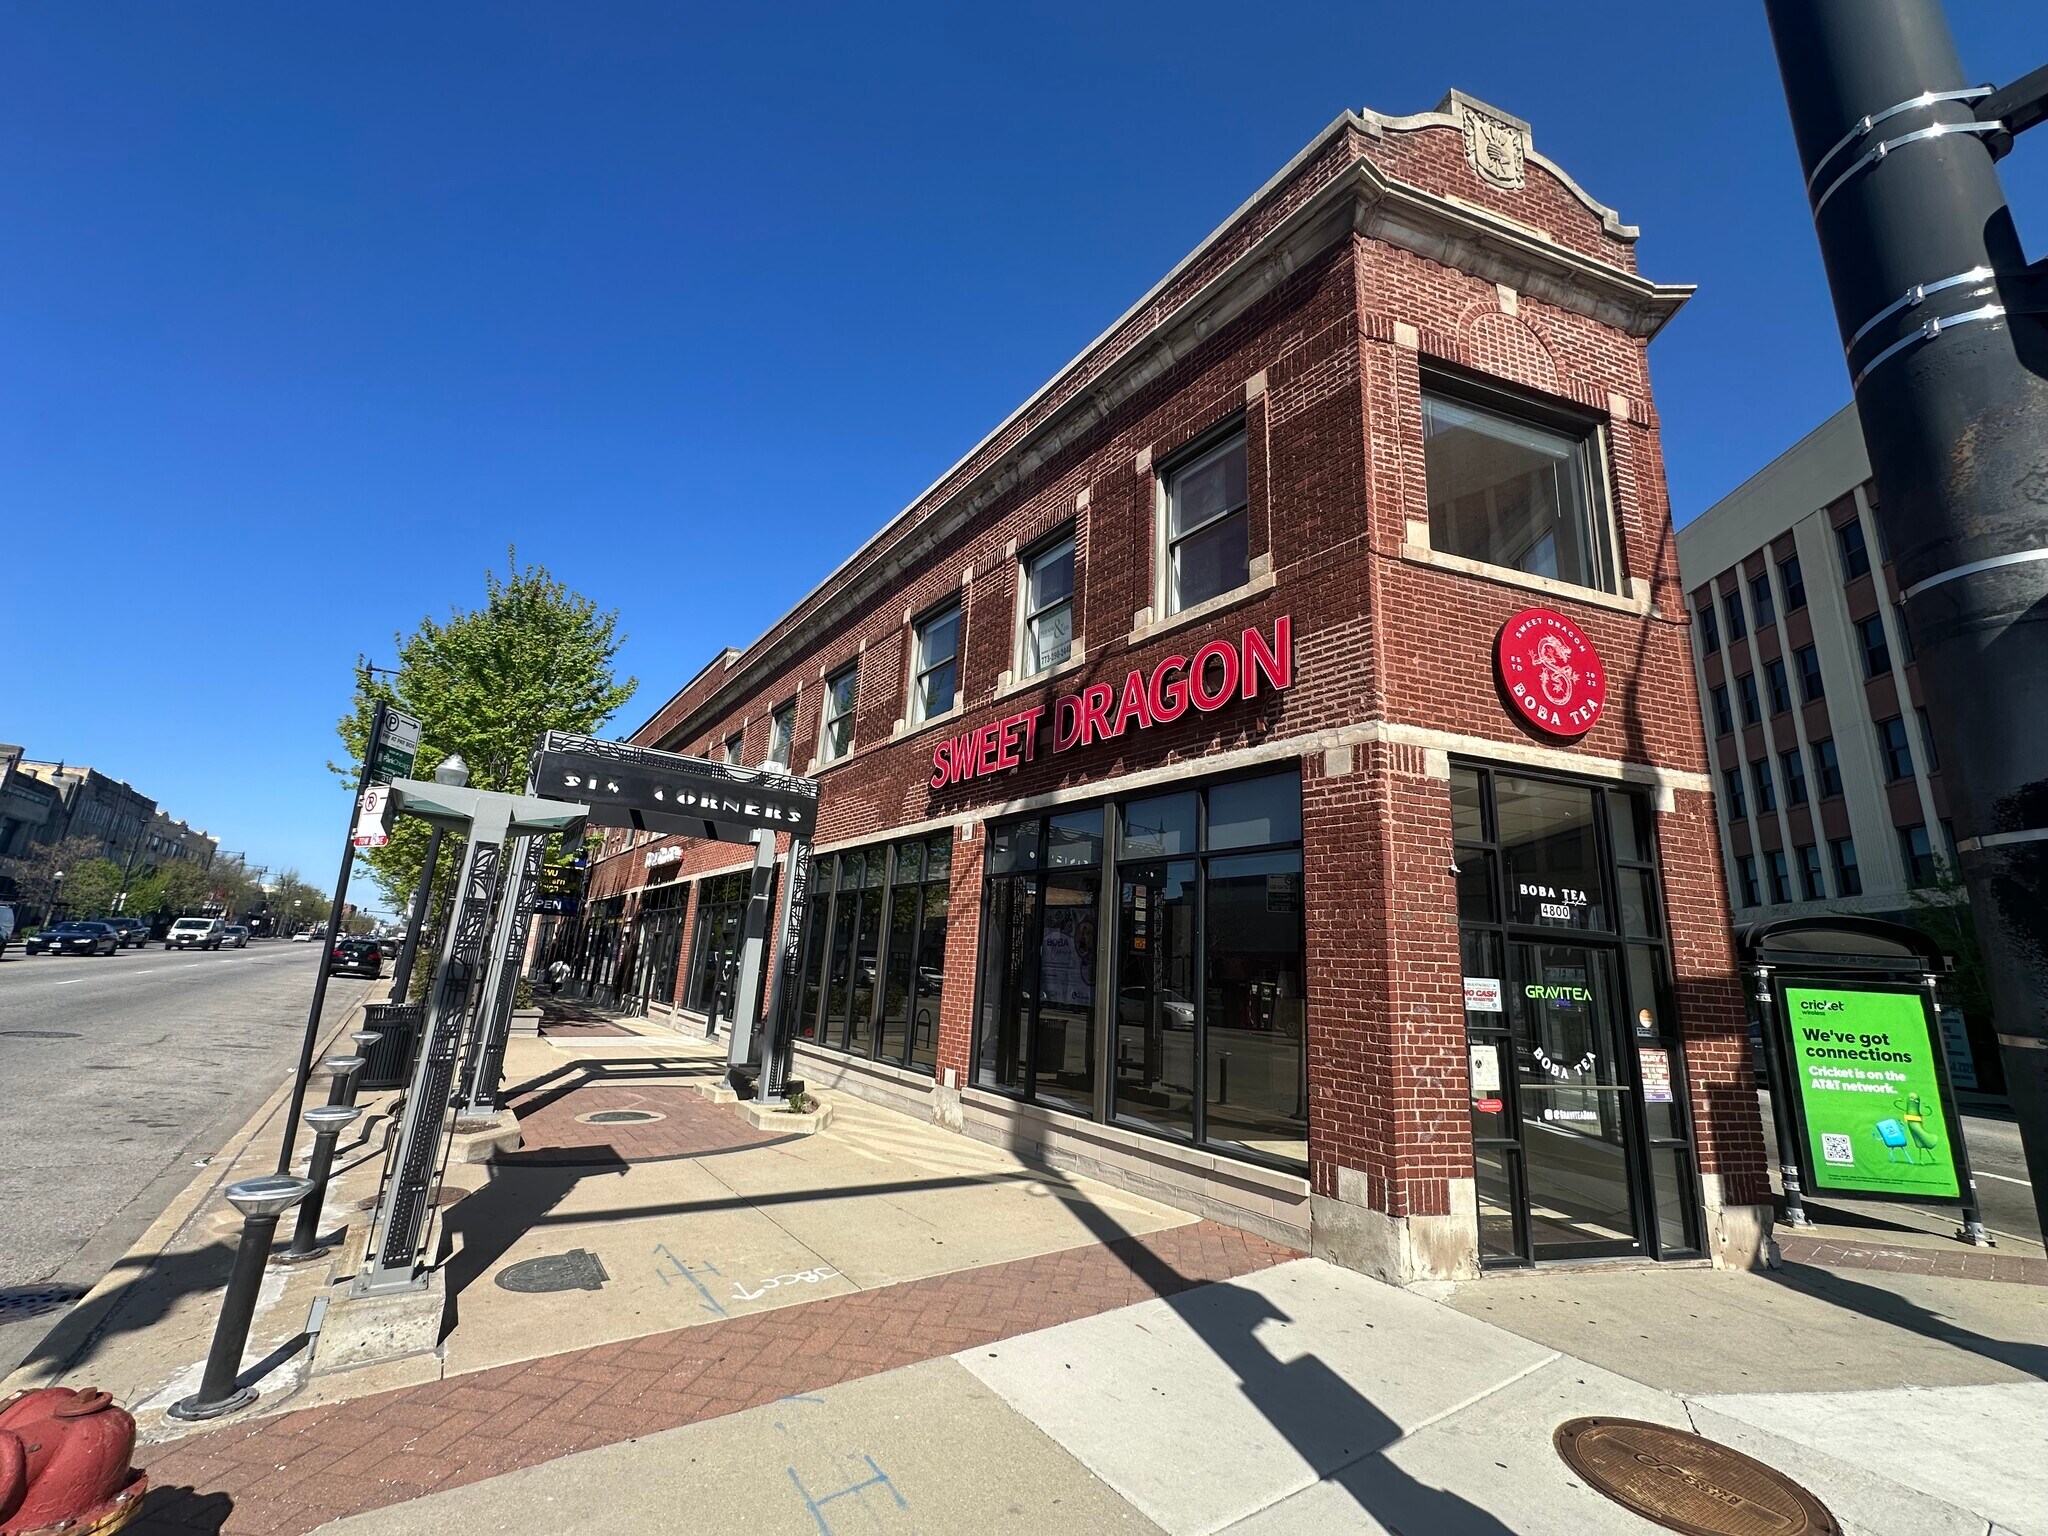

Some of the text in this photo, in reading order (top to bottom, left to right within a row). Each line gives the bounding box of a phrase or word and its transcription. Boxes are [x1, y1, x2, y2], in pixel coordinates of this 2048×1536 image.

[1515, 618, 1587, 653] SWEET DRAGON
[930, 614, 1292, 789] SWEET DRAGON
[1513, 682, 1599, 726] BOBA TEA
[562, 768, 802, 823] SIX CORNERS
[1520, 883, 1587, 902] BOBA TEA
[535, 899, 562, 910] PEN
[1542, 904, 1569, 917] 4800
[1476, 990, 1497, 998] CASH
[1525, 985, 1592, 1001] GRAVITEA
[1800, 999, 1844, 1011] cricket
[1802, 1027, 1890, 1047] We've got
[1533, 1046, 1597, 1080] BOBA TEA
[1806, 1046, 1912, 1063] connections
[1808, 1065, 1907, 1082] Cricket is on the
[1811, 1078, 1898, 1095] AT&T network.
